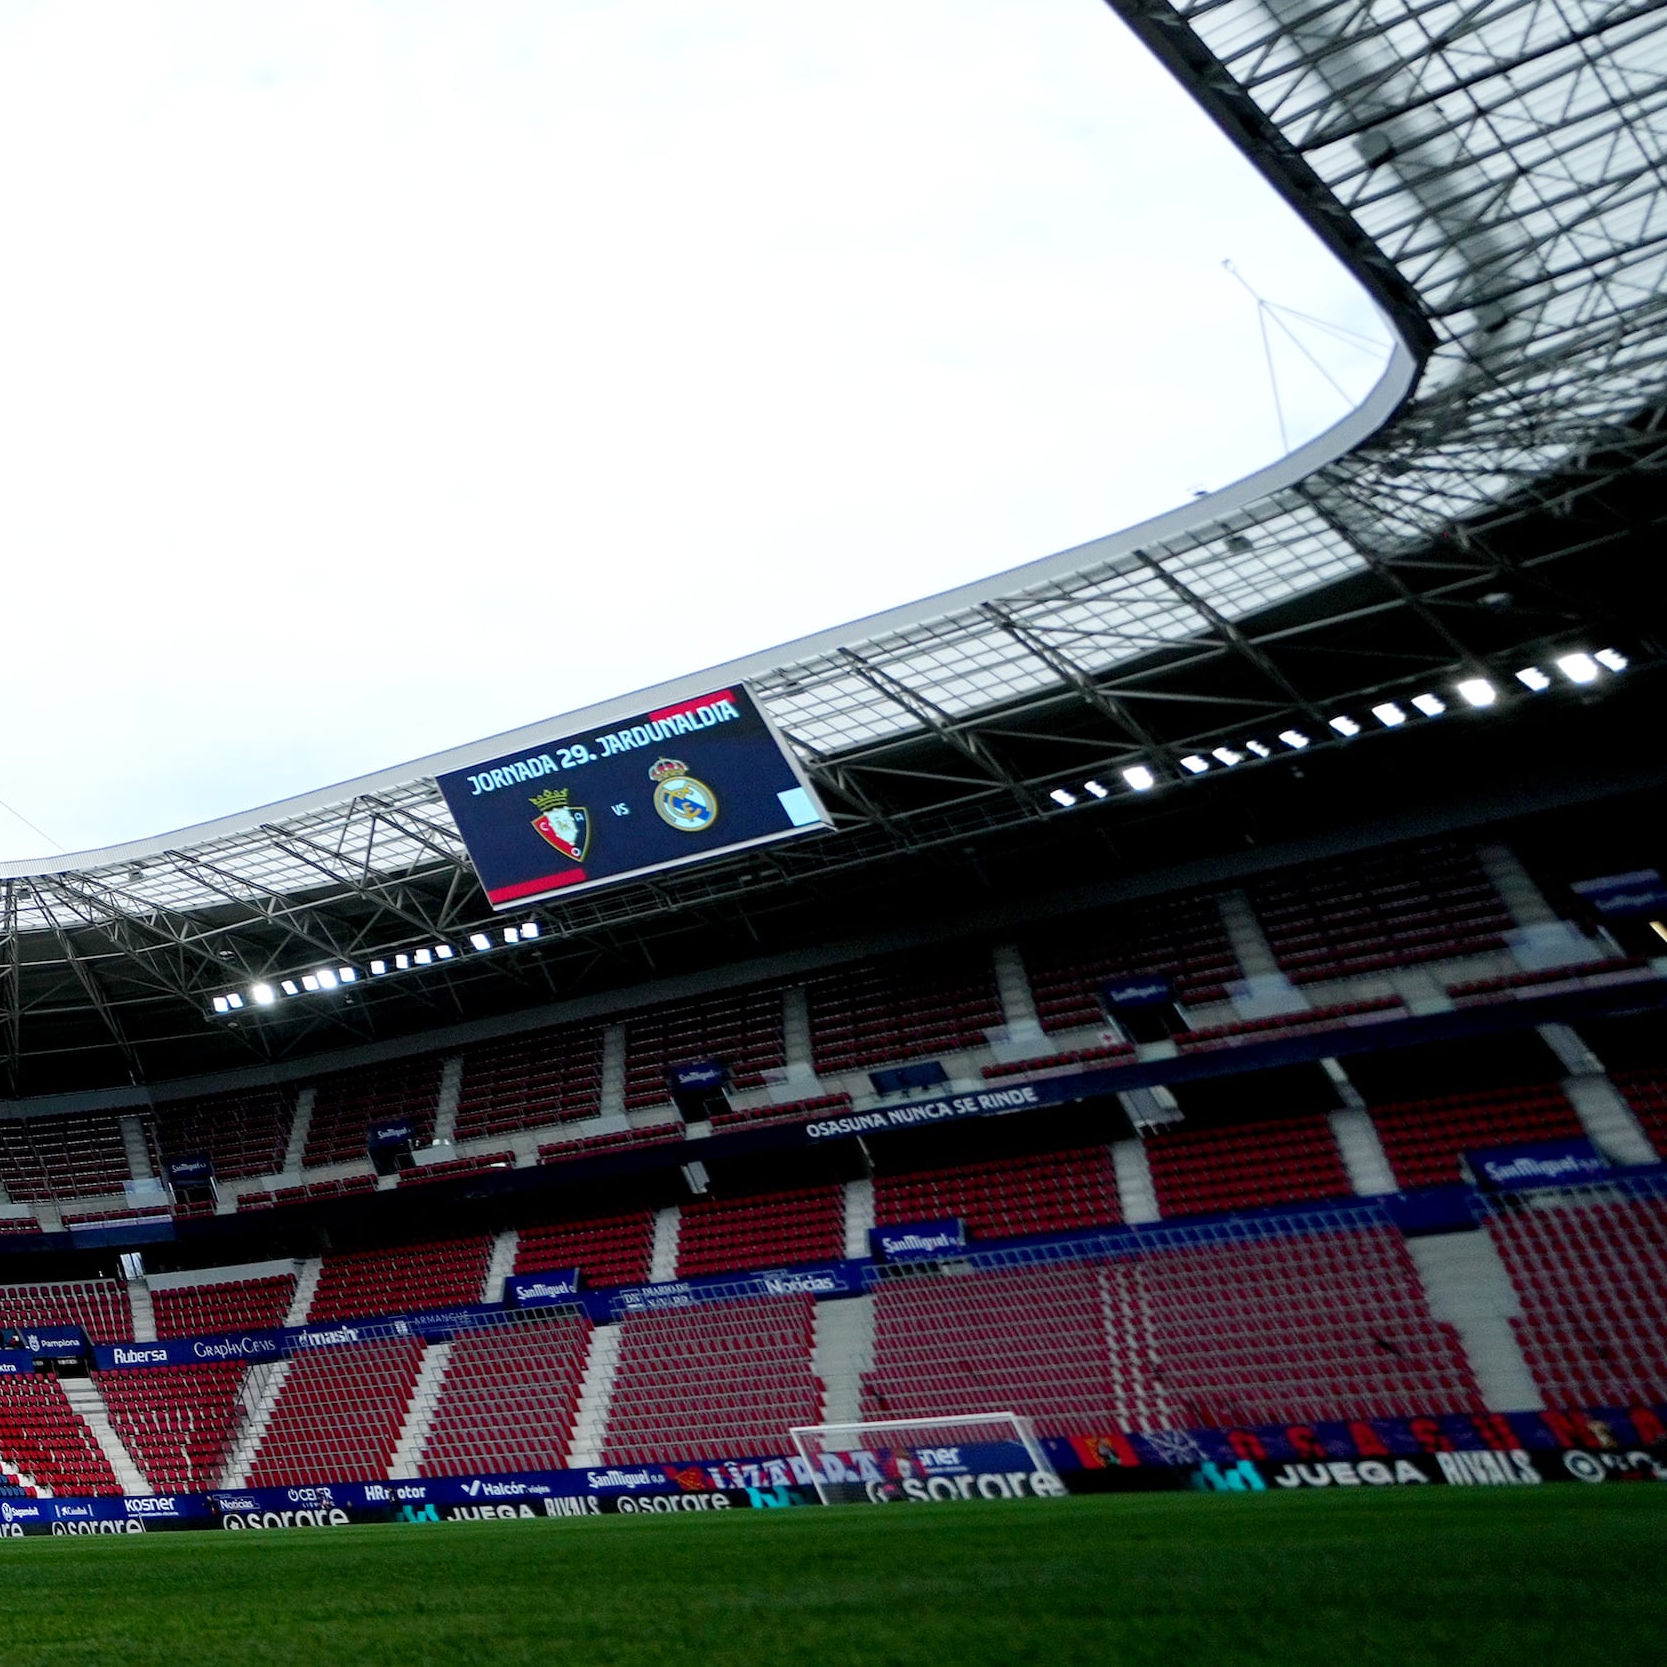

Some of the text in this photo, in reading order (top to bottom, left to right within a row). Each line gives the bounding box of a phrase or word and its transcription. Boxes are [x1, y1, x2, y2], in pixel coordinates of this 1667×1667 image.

[466, 698, 740, 796] JORNADA 29. JARDUNALDIA
[806, 1086, 1038, 1138] OSASUNA NUNCA SE RINDE
[40, 1338, 80, 1350] Pamplona
[114, 1346, 167, 1365] Rubersa
[1273, 1460, 1428, 1488] JUEGA
[1435, 1449, 1542, 1486] RIVALS
[639, 1490, 731, 1514] sorare
[901, 1469, 1069, 1504] sorare
